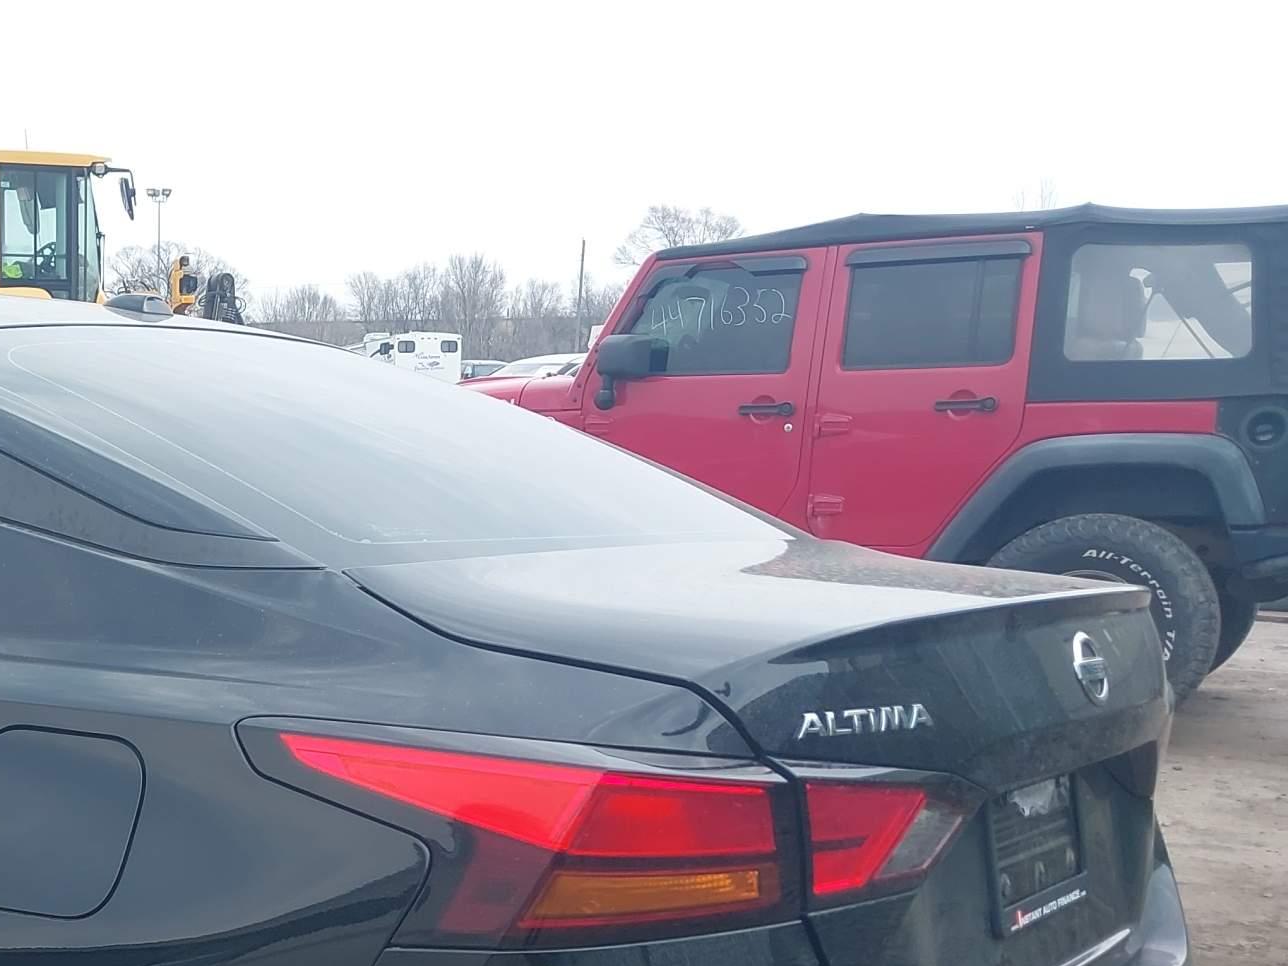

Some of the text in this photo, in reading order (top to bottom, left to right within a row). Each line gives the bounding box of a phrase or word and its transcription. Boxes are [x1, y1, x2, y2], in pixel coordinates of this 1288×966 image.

[651, 286, 793, 338] 44716352
[795, 703, 934, 740] ALTIMA
[1043, 900, 1058, 916] AUTO
